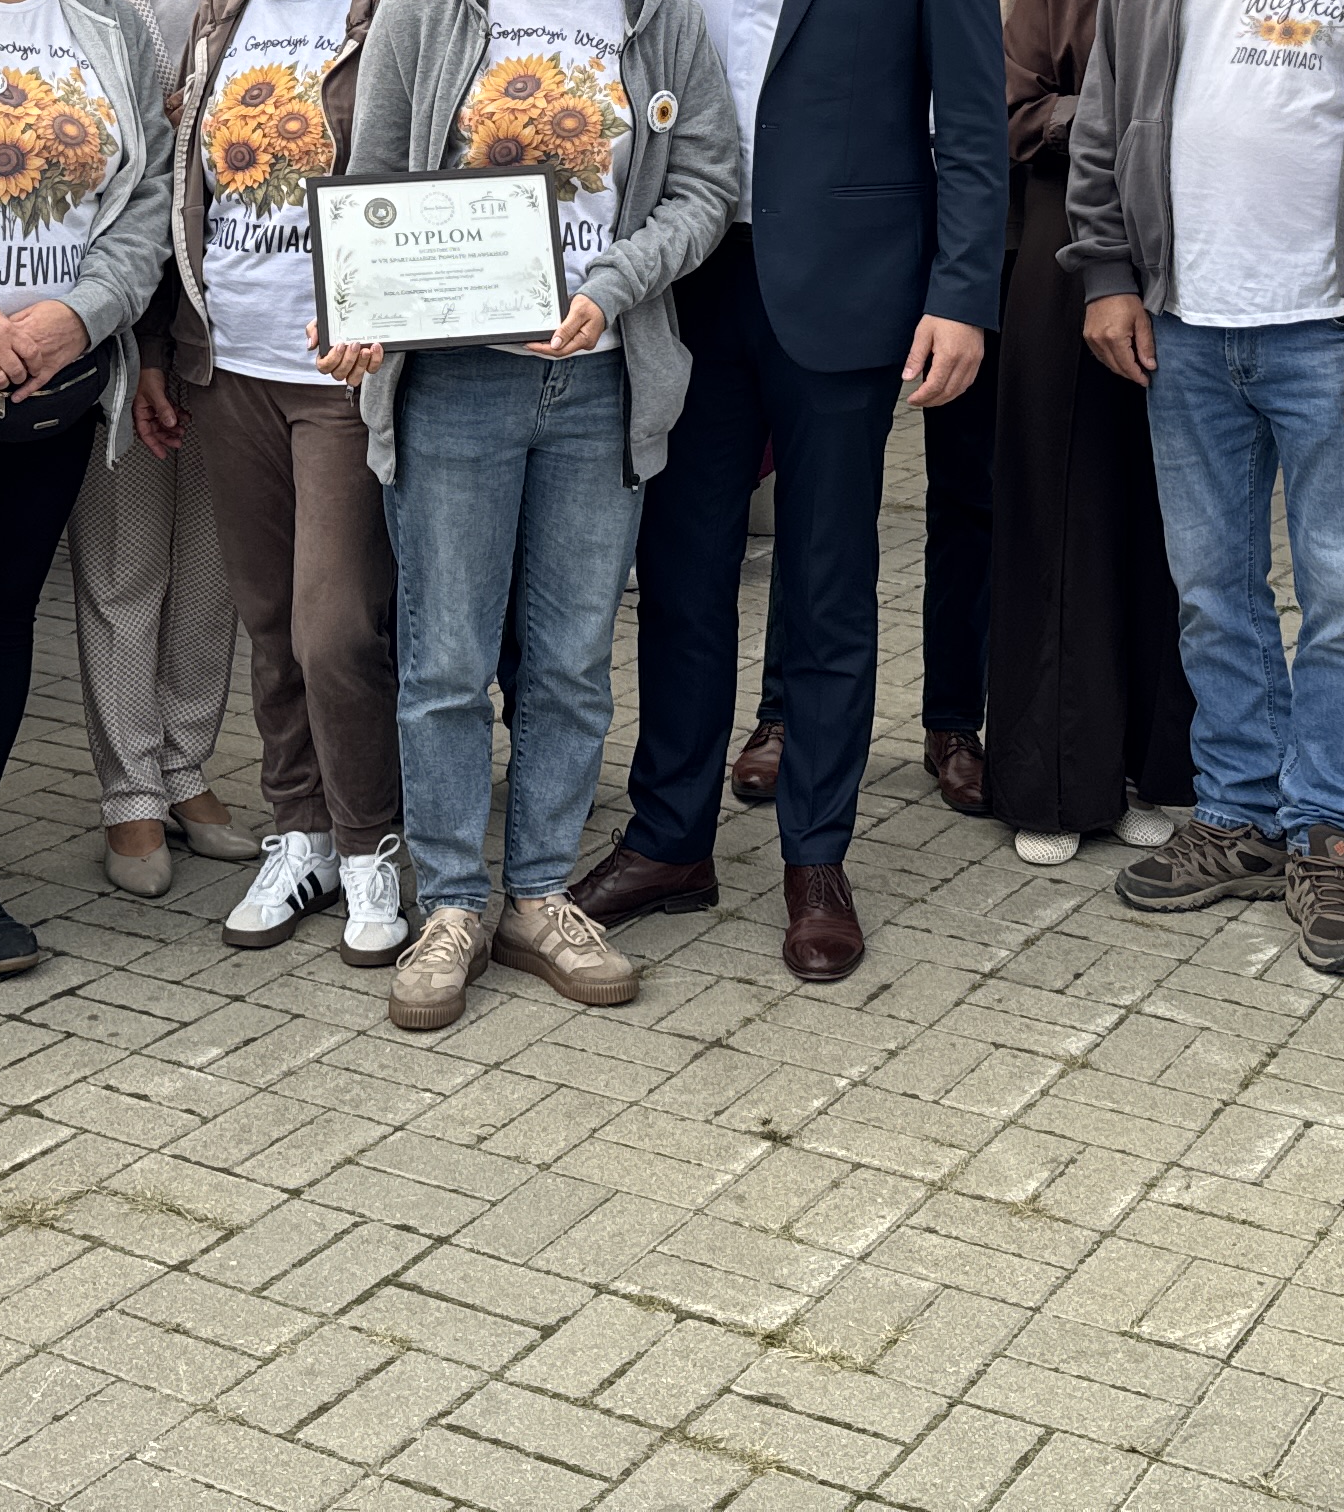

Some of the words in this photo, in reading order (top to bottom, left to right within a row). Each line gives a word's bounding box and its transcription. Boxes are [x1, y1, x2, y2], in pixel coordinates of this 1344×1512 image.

[490, 22, 567, 46] Gospodyń
[1230, 46, 1324, 71] ZDROJEWIACY
[470, 202, 507, 216] SEJM
[394, 228, 484, 247] DYPLOM
